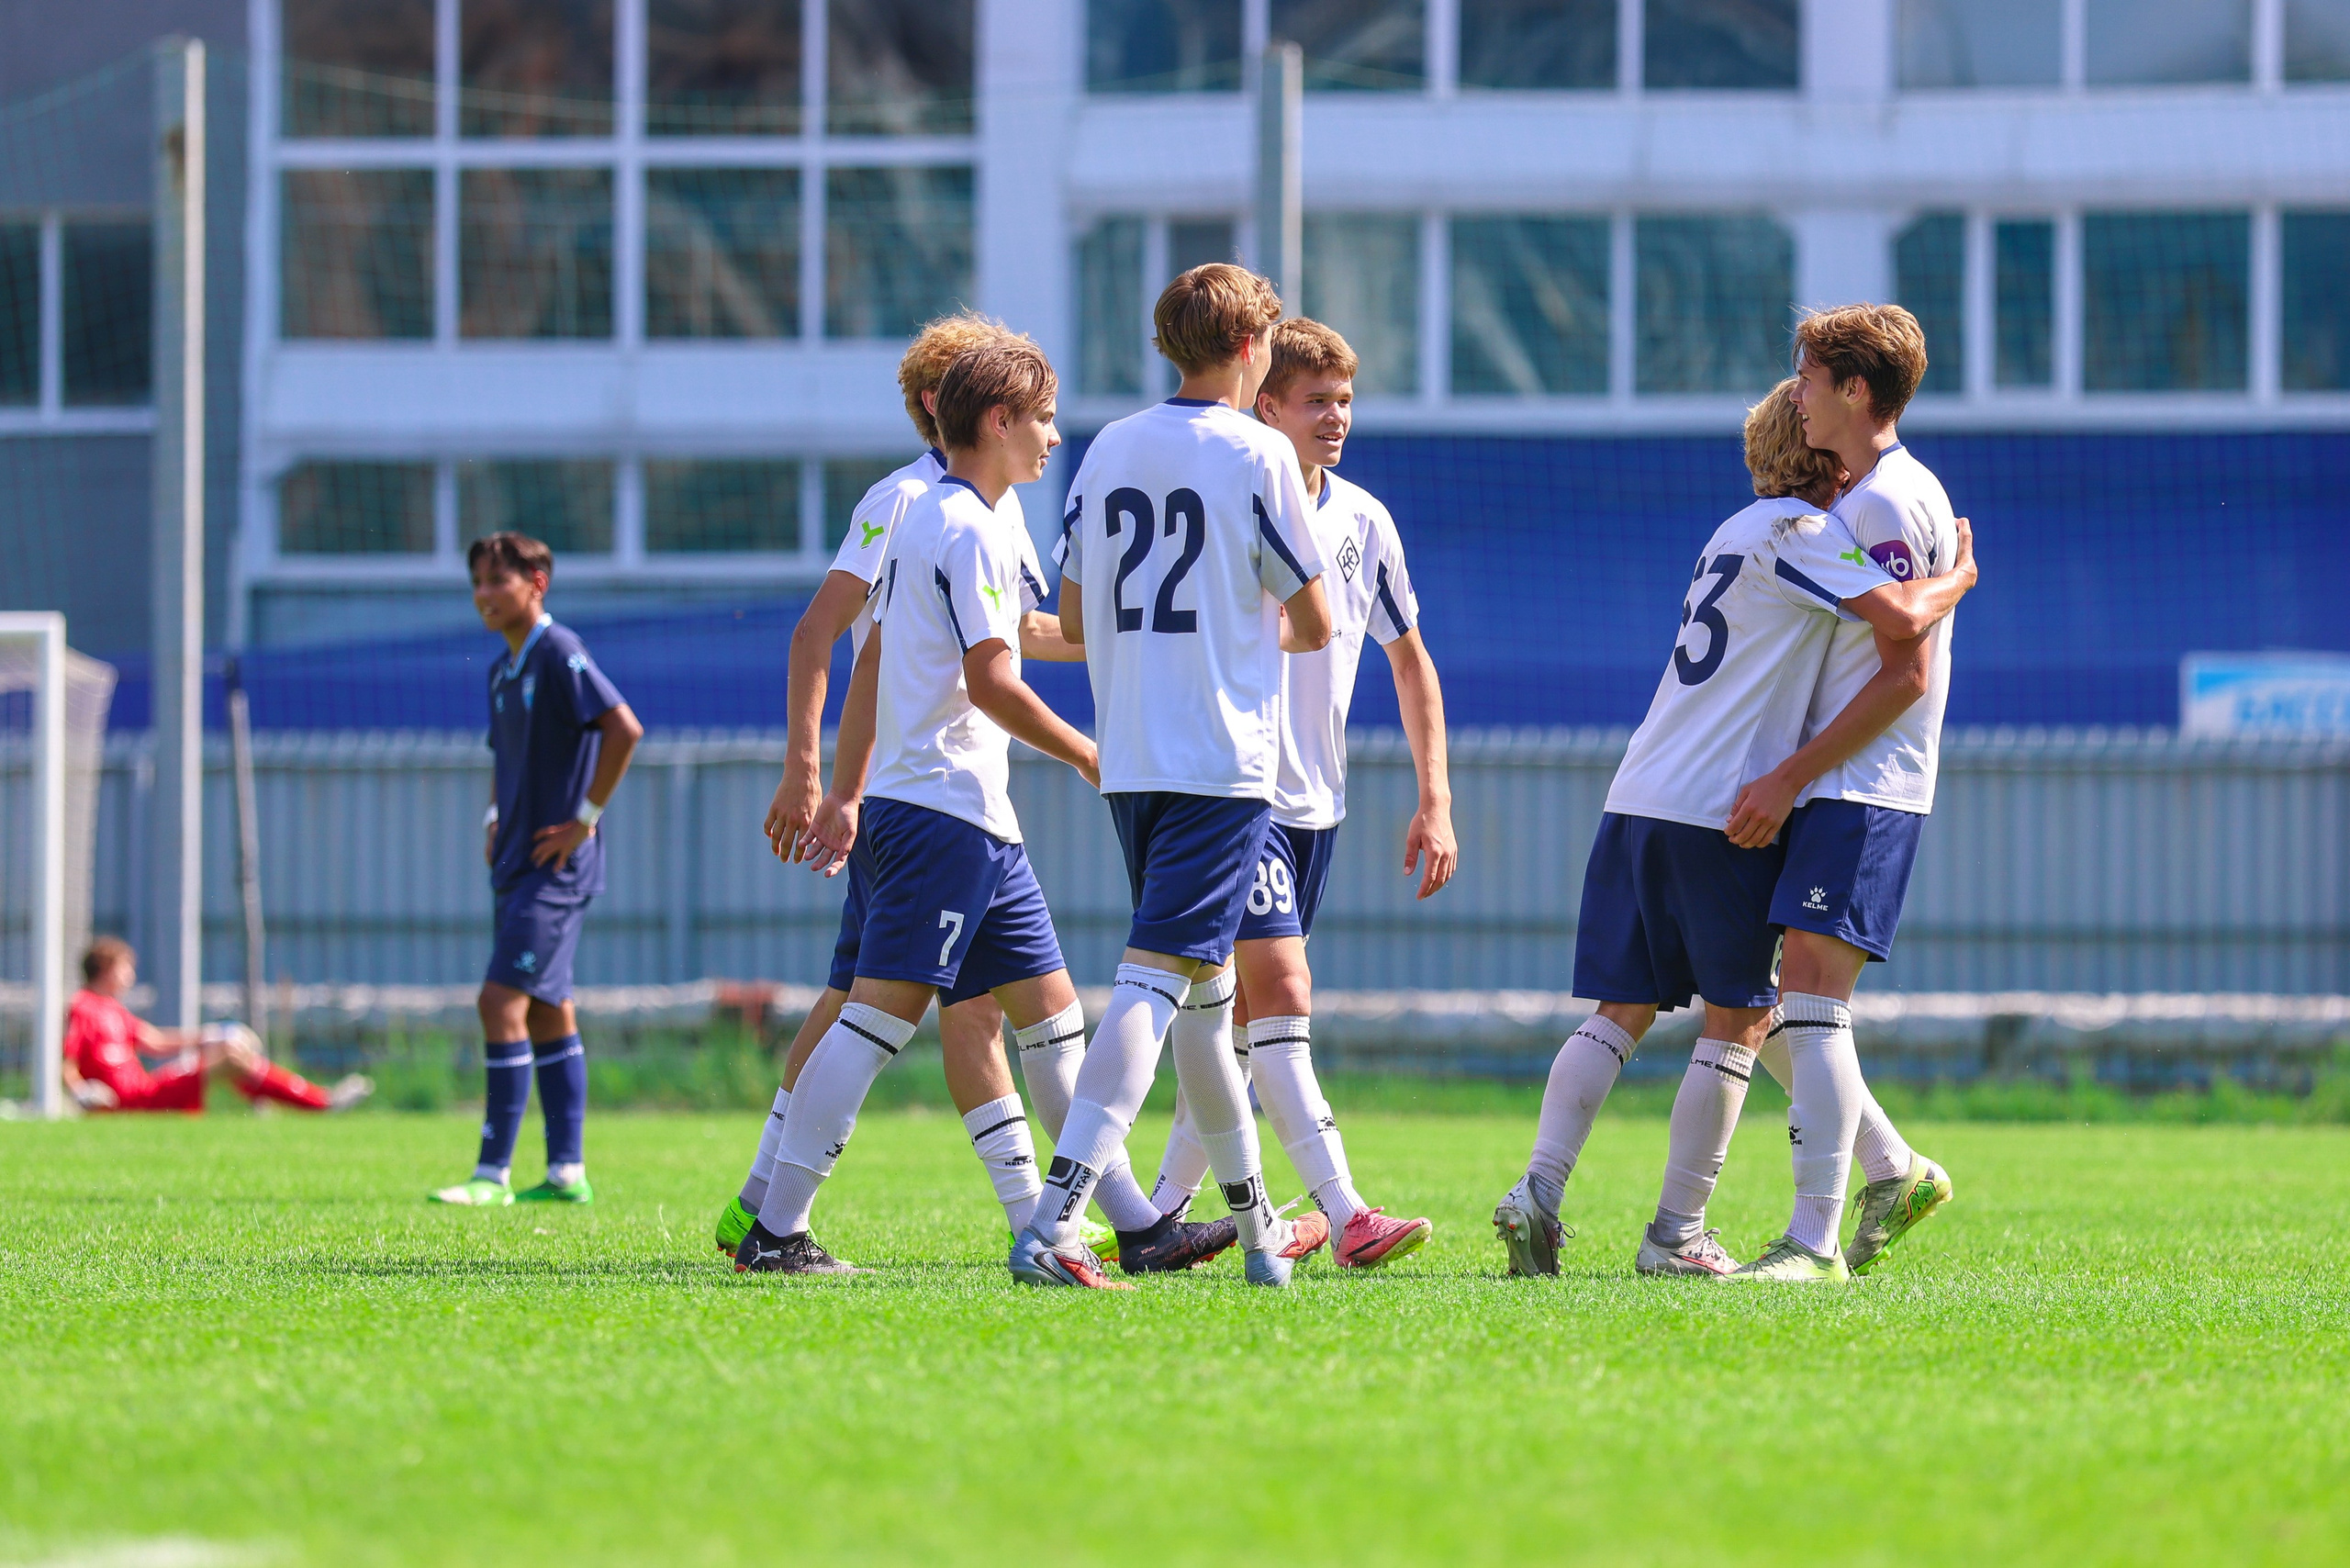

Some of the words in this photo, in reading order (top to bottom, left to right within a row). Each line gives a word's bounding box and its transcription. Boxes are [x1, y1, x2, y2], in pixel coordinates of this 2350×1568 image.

[1105, 487, 1205, 633] 22
[1247, 857, 1292, 915] 89
[1802, 901, 1829, 912] KELME
[938, 909, 965, 967] 7
[1574, 1030, 1619, 1056] KELME
